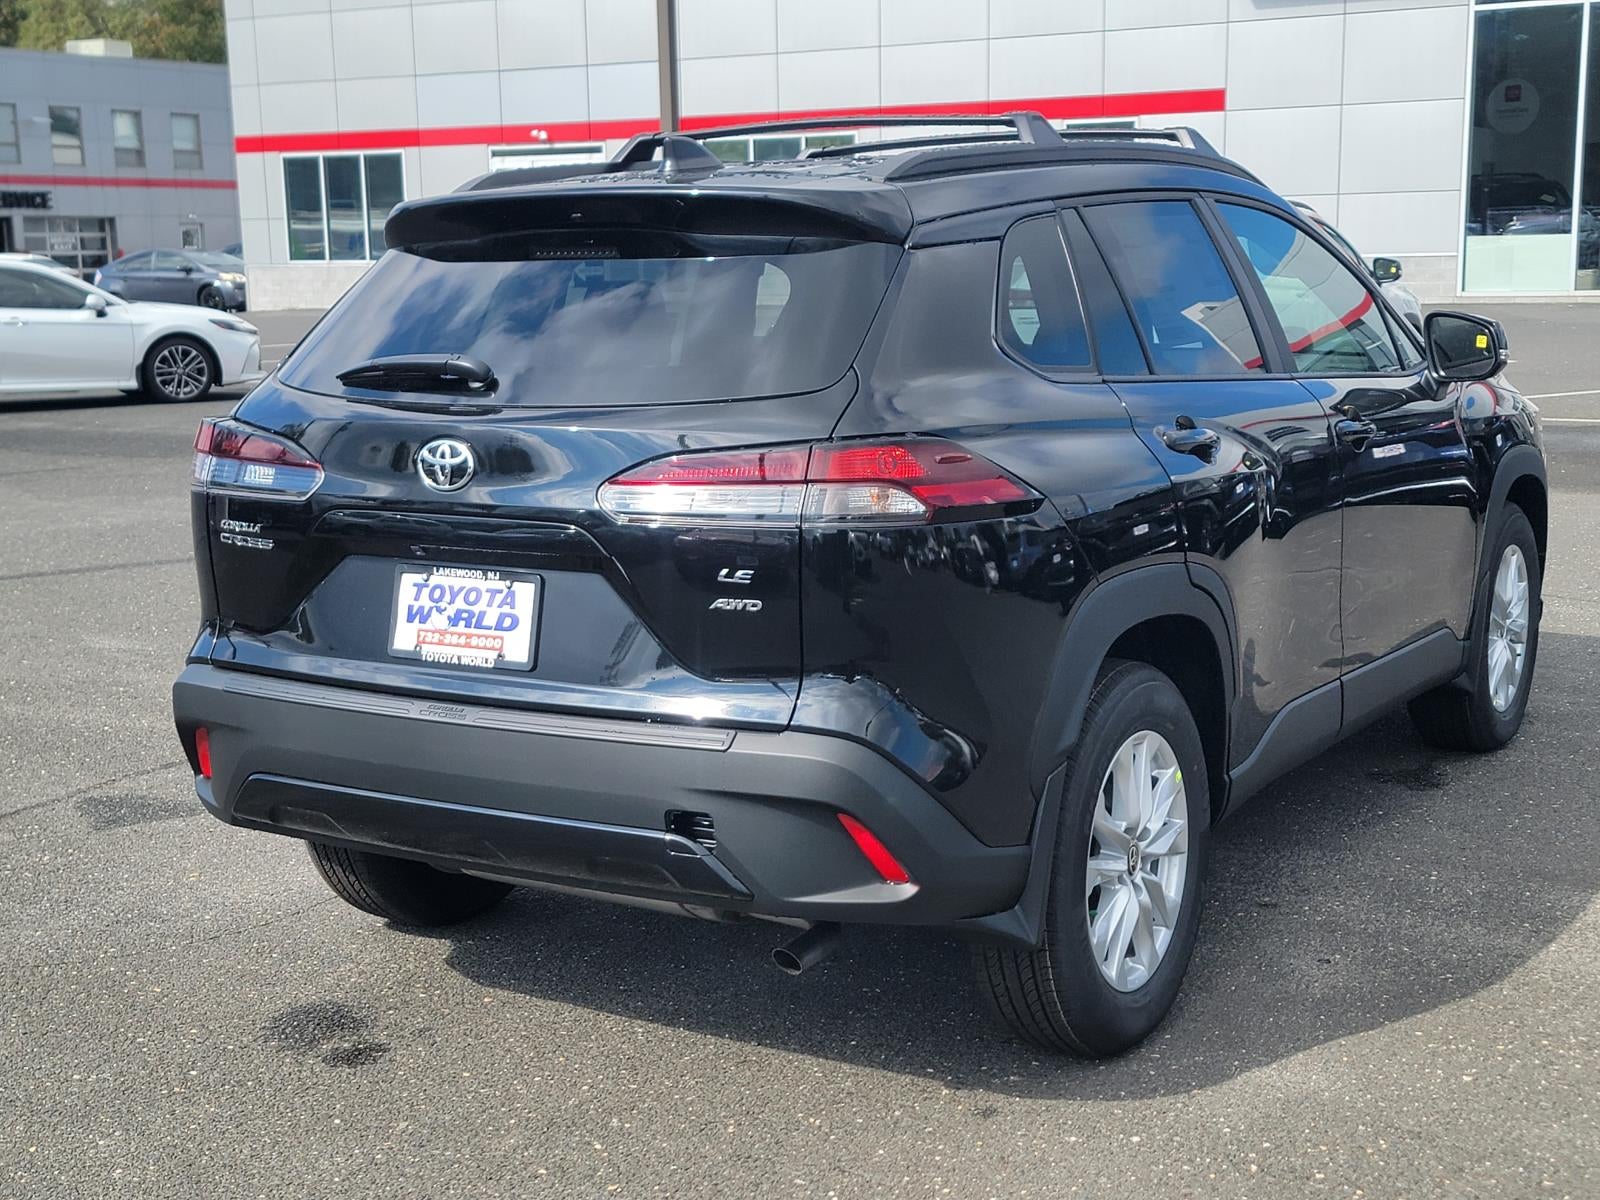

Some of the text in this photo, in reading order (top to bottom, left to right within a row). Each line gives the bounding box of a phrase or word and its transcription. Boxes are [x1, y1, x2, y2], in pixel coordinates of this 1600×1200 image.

[220, 532, 275, 549] CROSS
[433, 567, 500, 580] LAKEWOOD, NJ
[717, 568, 755, 584] LE
[412, 582, 517, 609] TOYOTA
[708, 598, 763, 612] AWD
[406, 602, 520, 632] WORLD
[421, 651, 495, 668] TOYOTA WORLD
